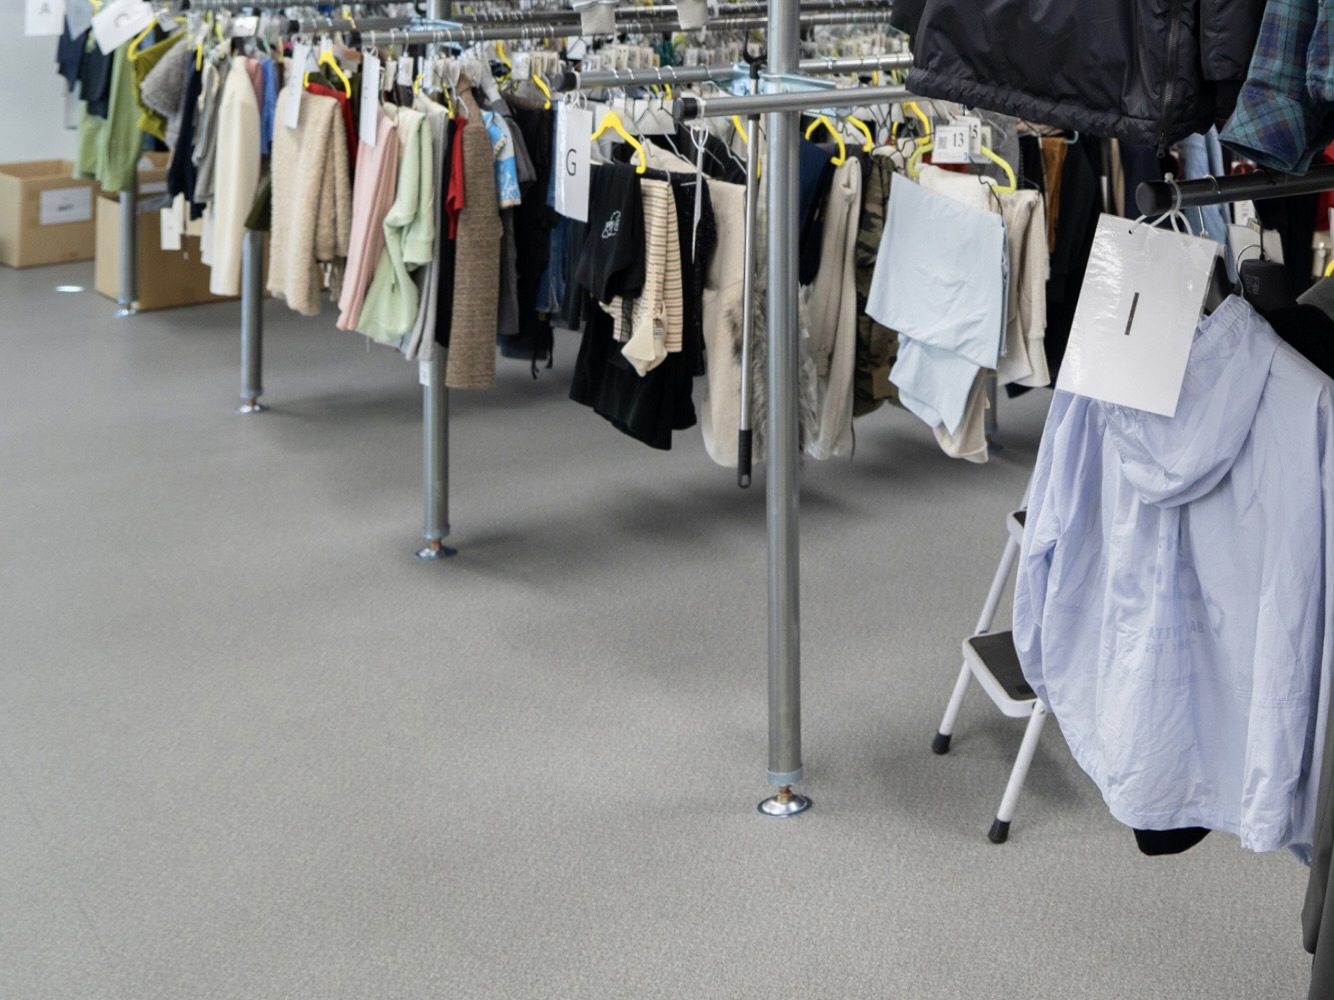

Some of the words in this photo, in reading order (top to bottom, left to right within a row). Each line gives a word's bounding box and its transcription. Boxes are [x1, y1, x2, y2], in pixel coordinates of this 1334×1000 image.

[953, 132, 964, 148] 13
[566, 148, 577, 177] G
[1124, 291, 1140, 336] I
